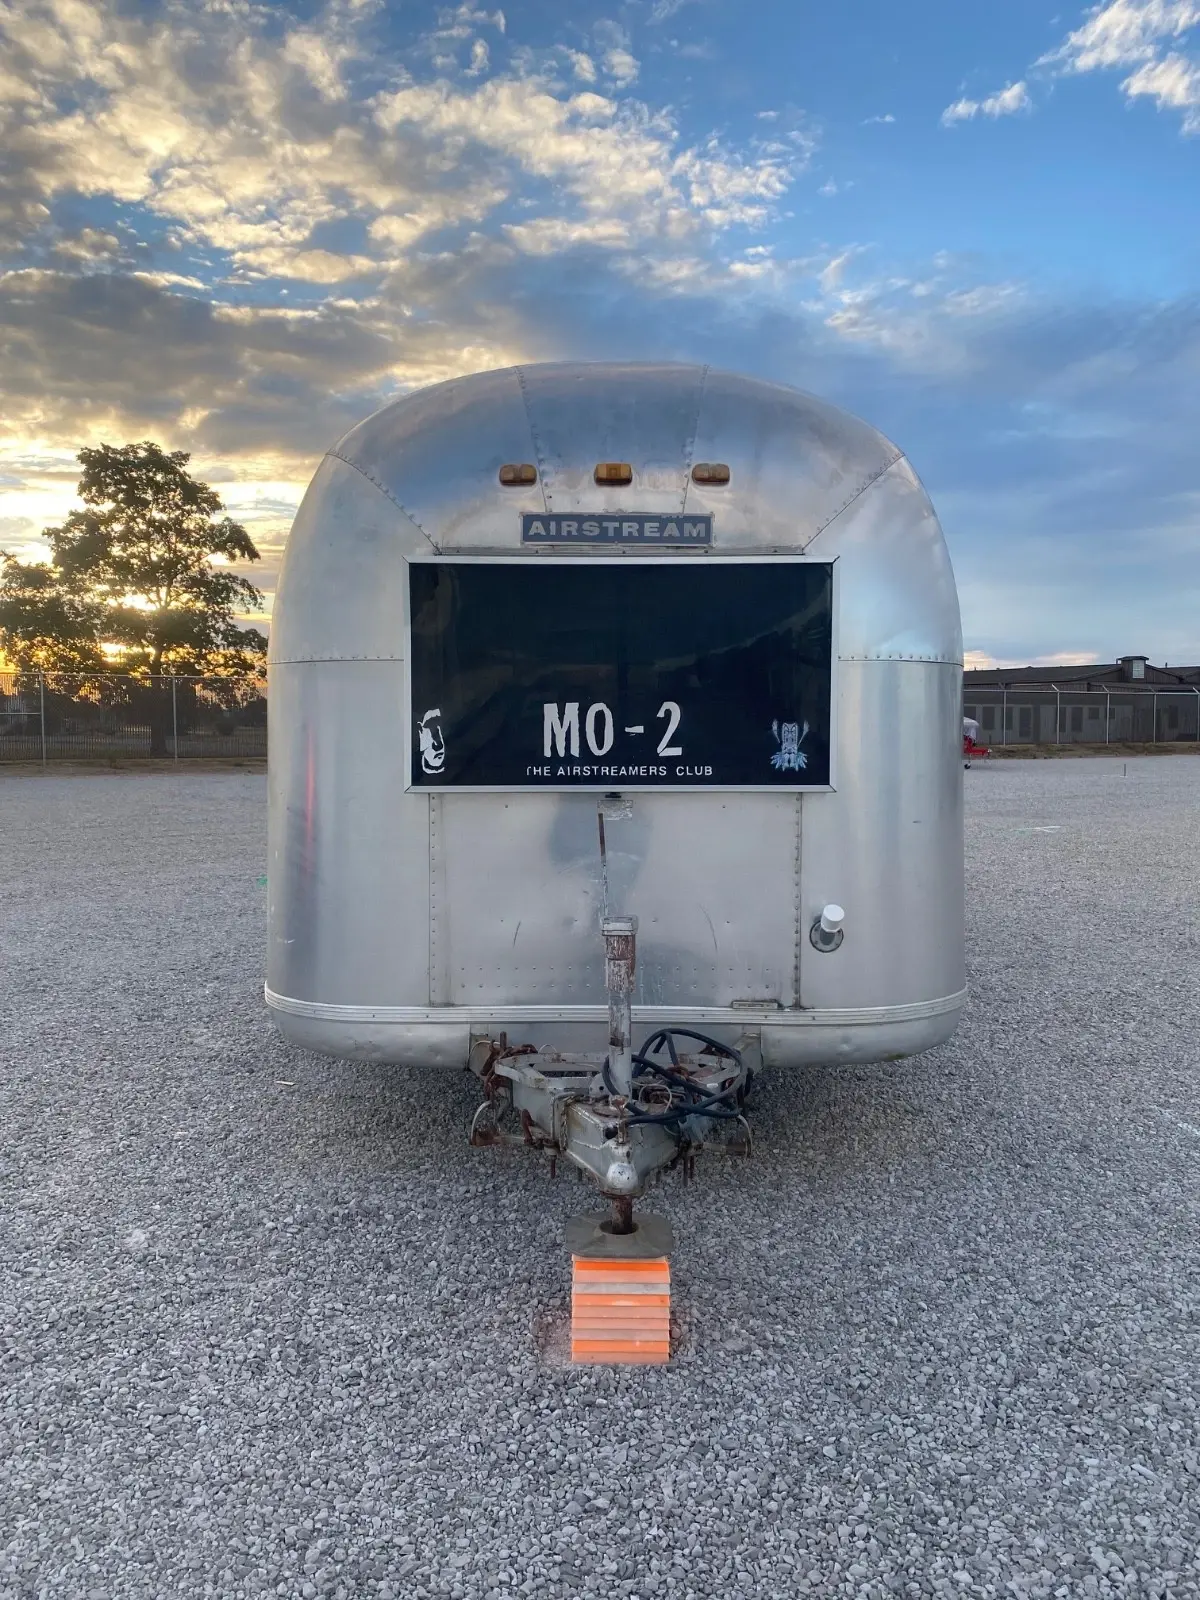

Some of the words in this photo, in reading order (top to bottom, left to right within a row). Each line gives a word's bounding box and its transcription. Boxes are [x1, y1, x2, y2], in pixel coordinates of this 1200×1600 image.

[528, 520, 706, 538] AIRSTREAM
[526, 765, 551, 777] THE
[556, 765, 667, 777] AIRSTREAMERS
[675, 765, 713, 777] CLUB
